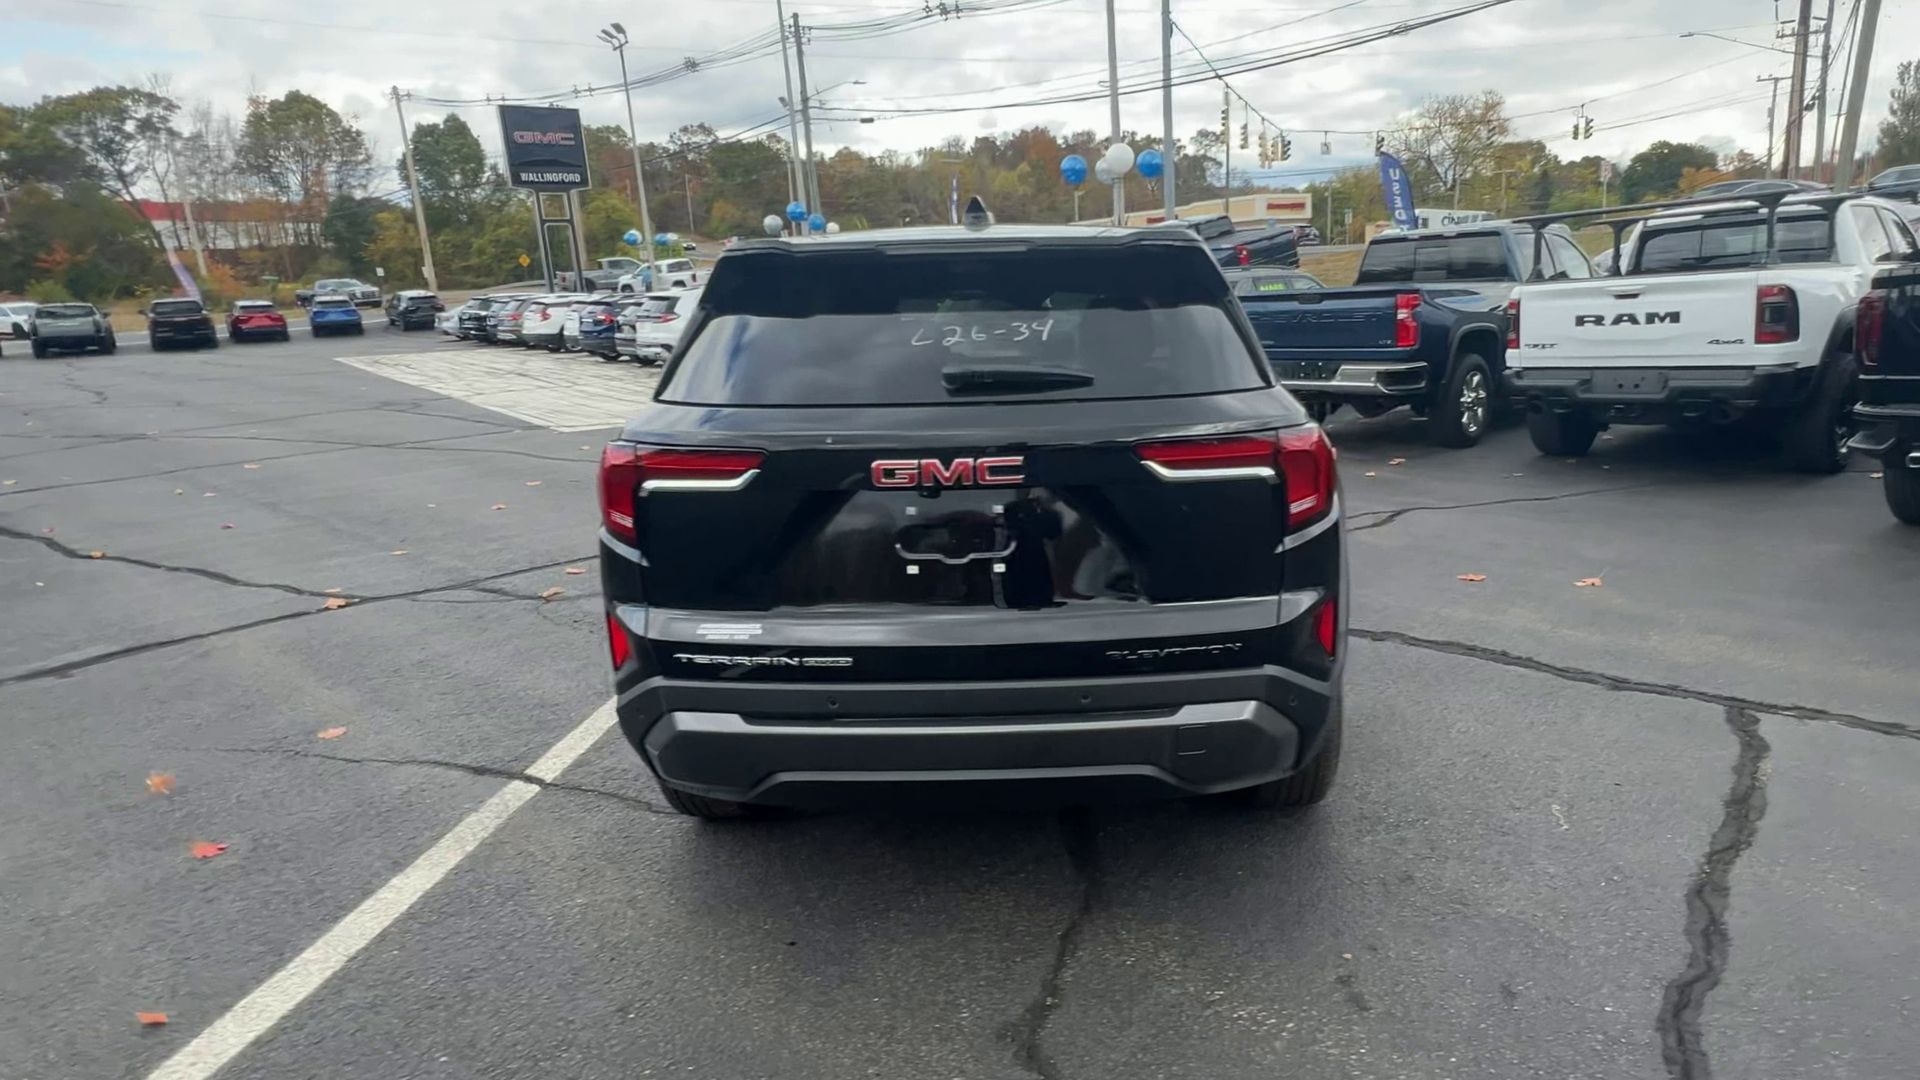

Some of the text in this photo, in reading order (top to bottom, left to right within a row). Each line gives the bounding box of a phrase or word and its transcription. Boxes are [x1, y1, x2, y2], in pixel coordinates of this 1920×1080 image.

[513, 131, 576, 146] GMC
[520, 172, 581, 182] WALLINGFORD
[1574, 311, 1682, 327] RAM
[870, 456, 1025, 487] GMC
[1105, 642, 1243, 660] ELEVATION
[672, 654, 800, 666] TERRAIN
